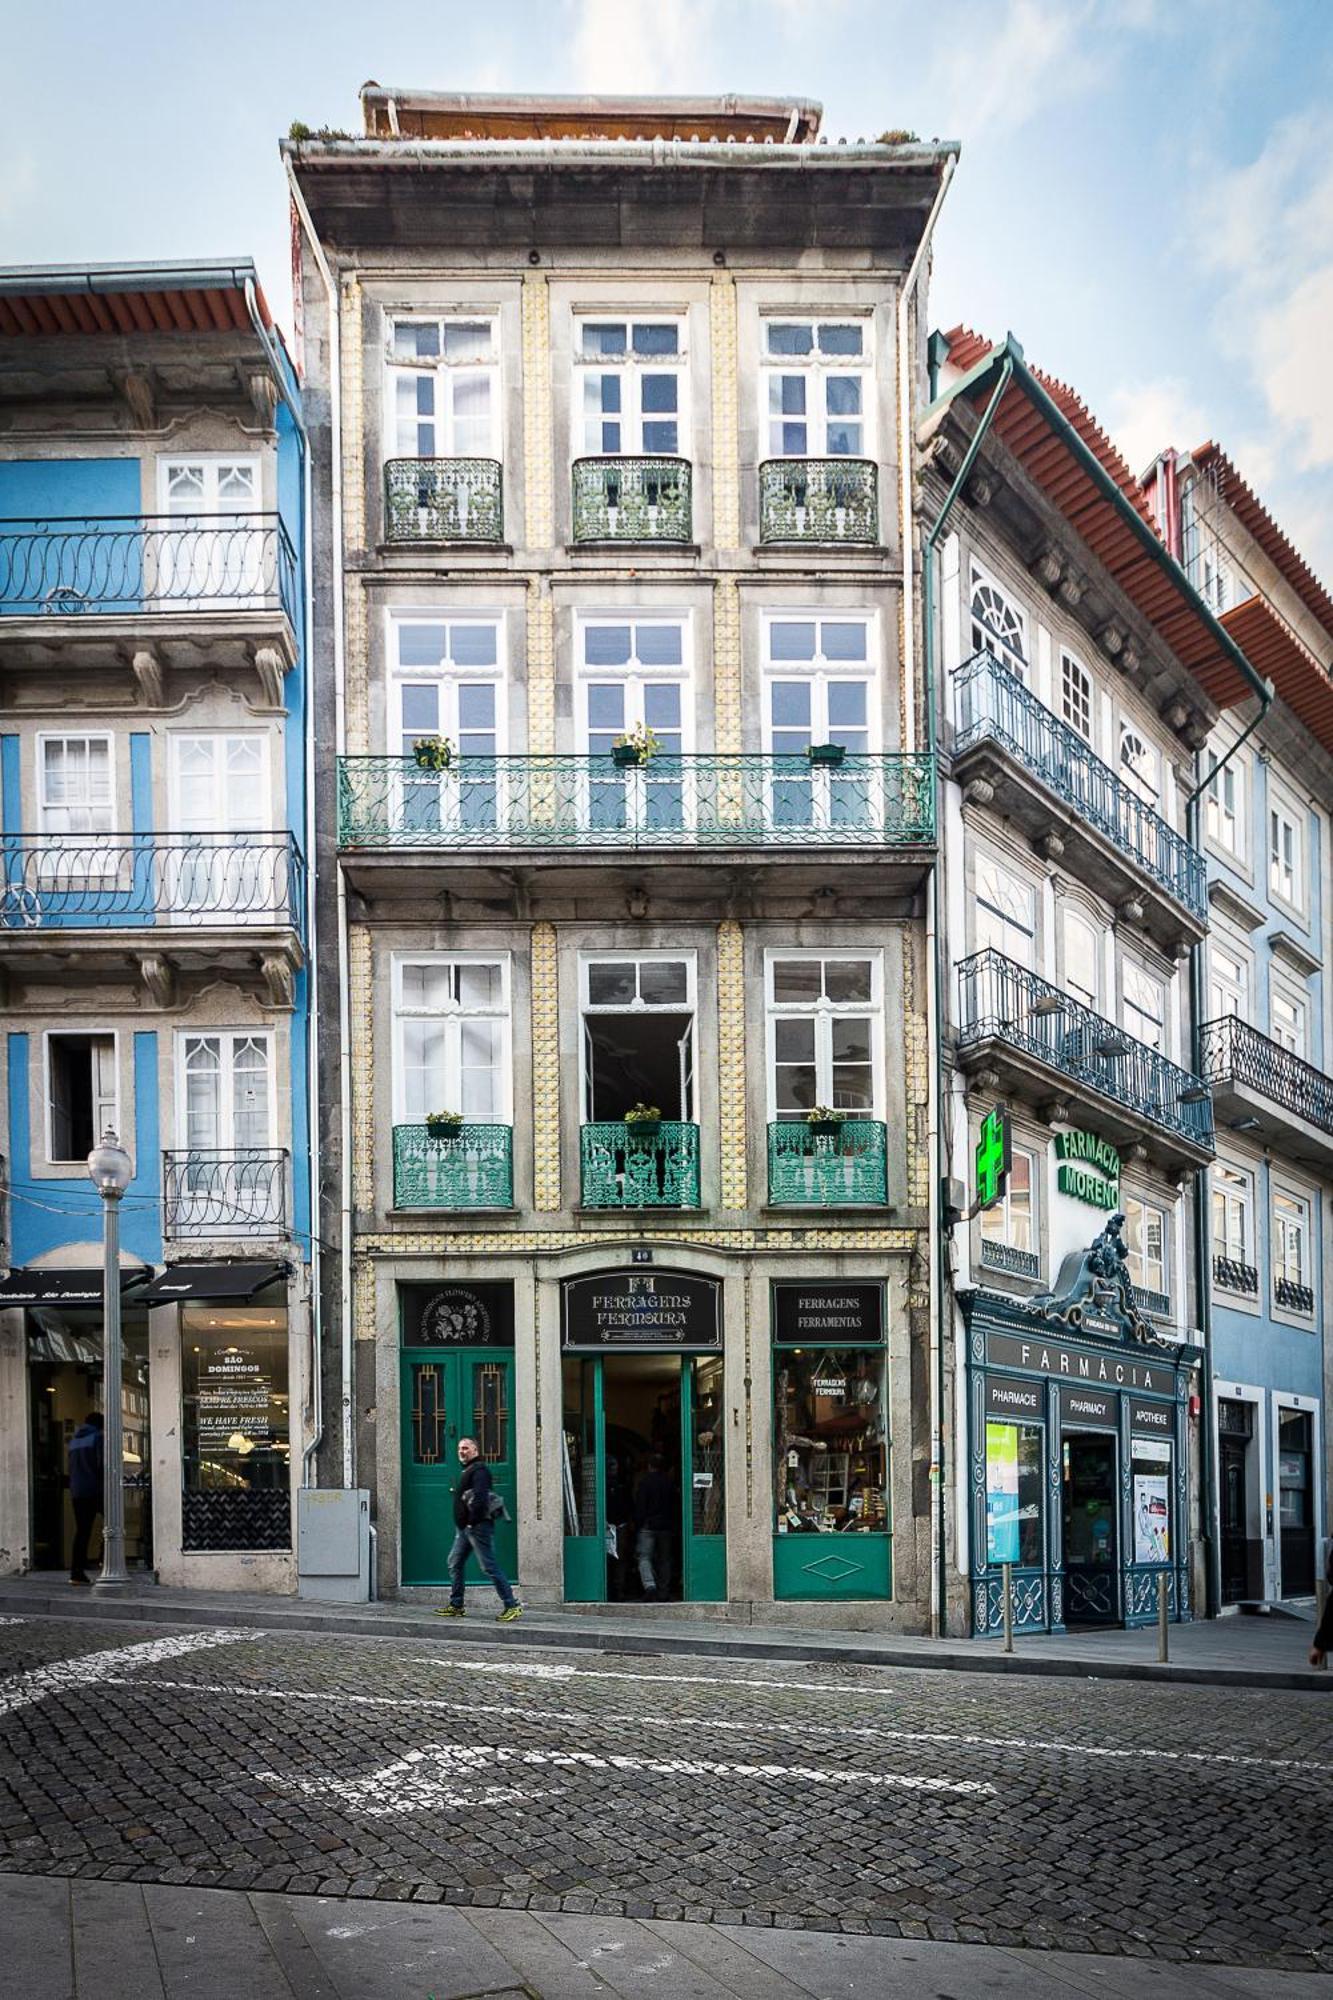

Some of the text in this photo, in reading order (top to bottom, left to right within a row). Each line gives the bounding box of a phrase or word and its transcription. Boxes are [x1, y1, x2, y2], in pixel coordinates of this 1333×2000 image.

[1065, 1165, 1119, 1209] MORENO
[592, 1296, 692, 1309] FERRAGENS
[798, 1297, 860, 1309] FERRAGENS
[597, 1312, 687, 1326] FERMOURA
[798, 1316, 862, 1328] FERRAMENTAS
[224, 1356, 243, 1364] SÃO
[1021, 1345, 1153, 1388] FARMÁCIA
[208, 1365, 260, 1373] DOMINGOS
[992, 1389, 1037, 1407] PHARMACIE
[1069, 1399, 1106, 1415] PHARMACY
[200, 1416, 269, 1425] WE HAVE FRESH
[1135, 1412, 1168, 1425] APOTHEKE
